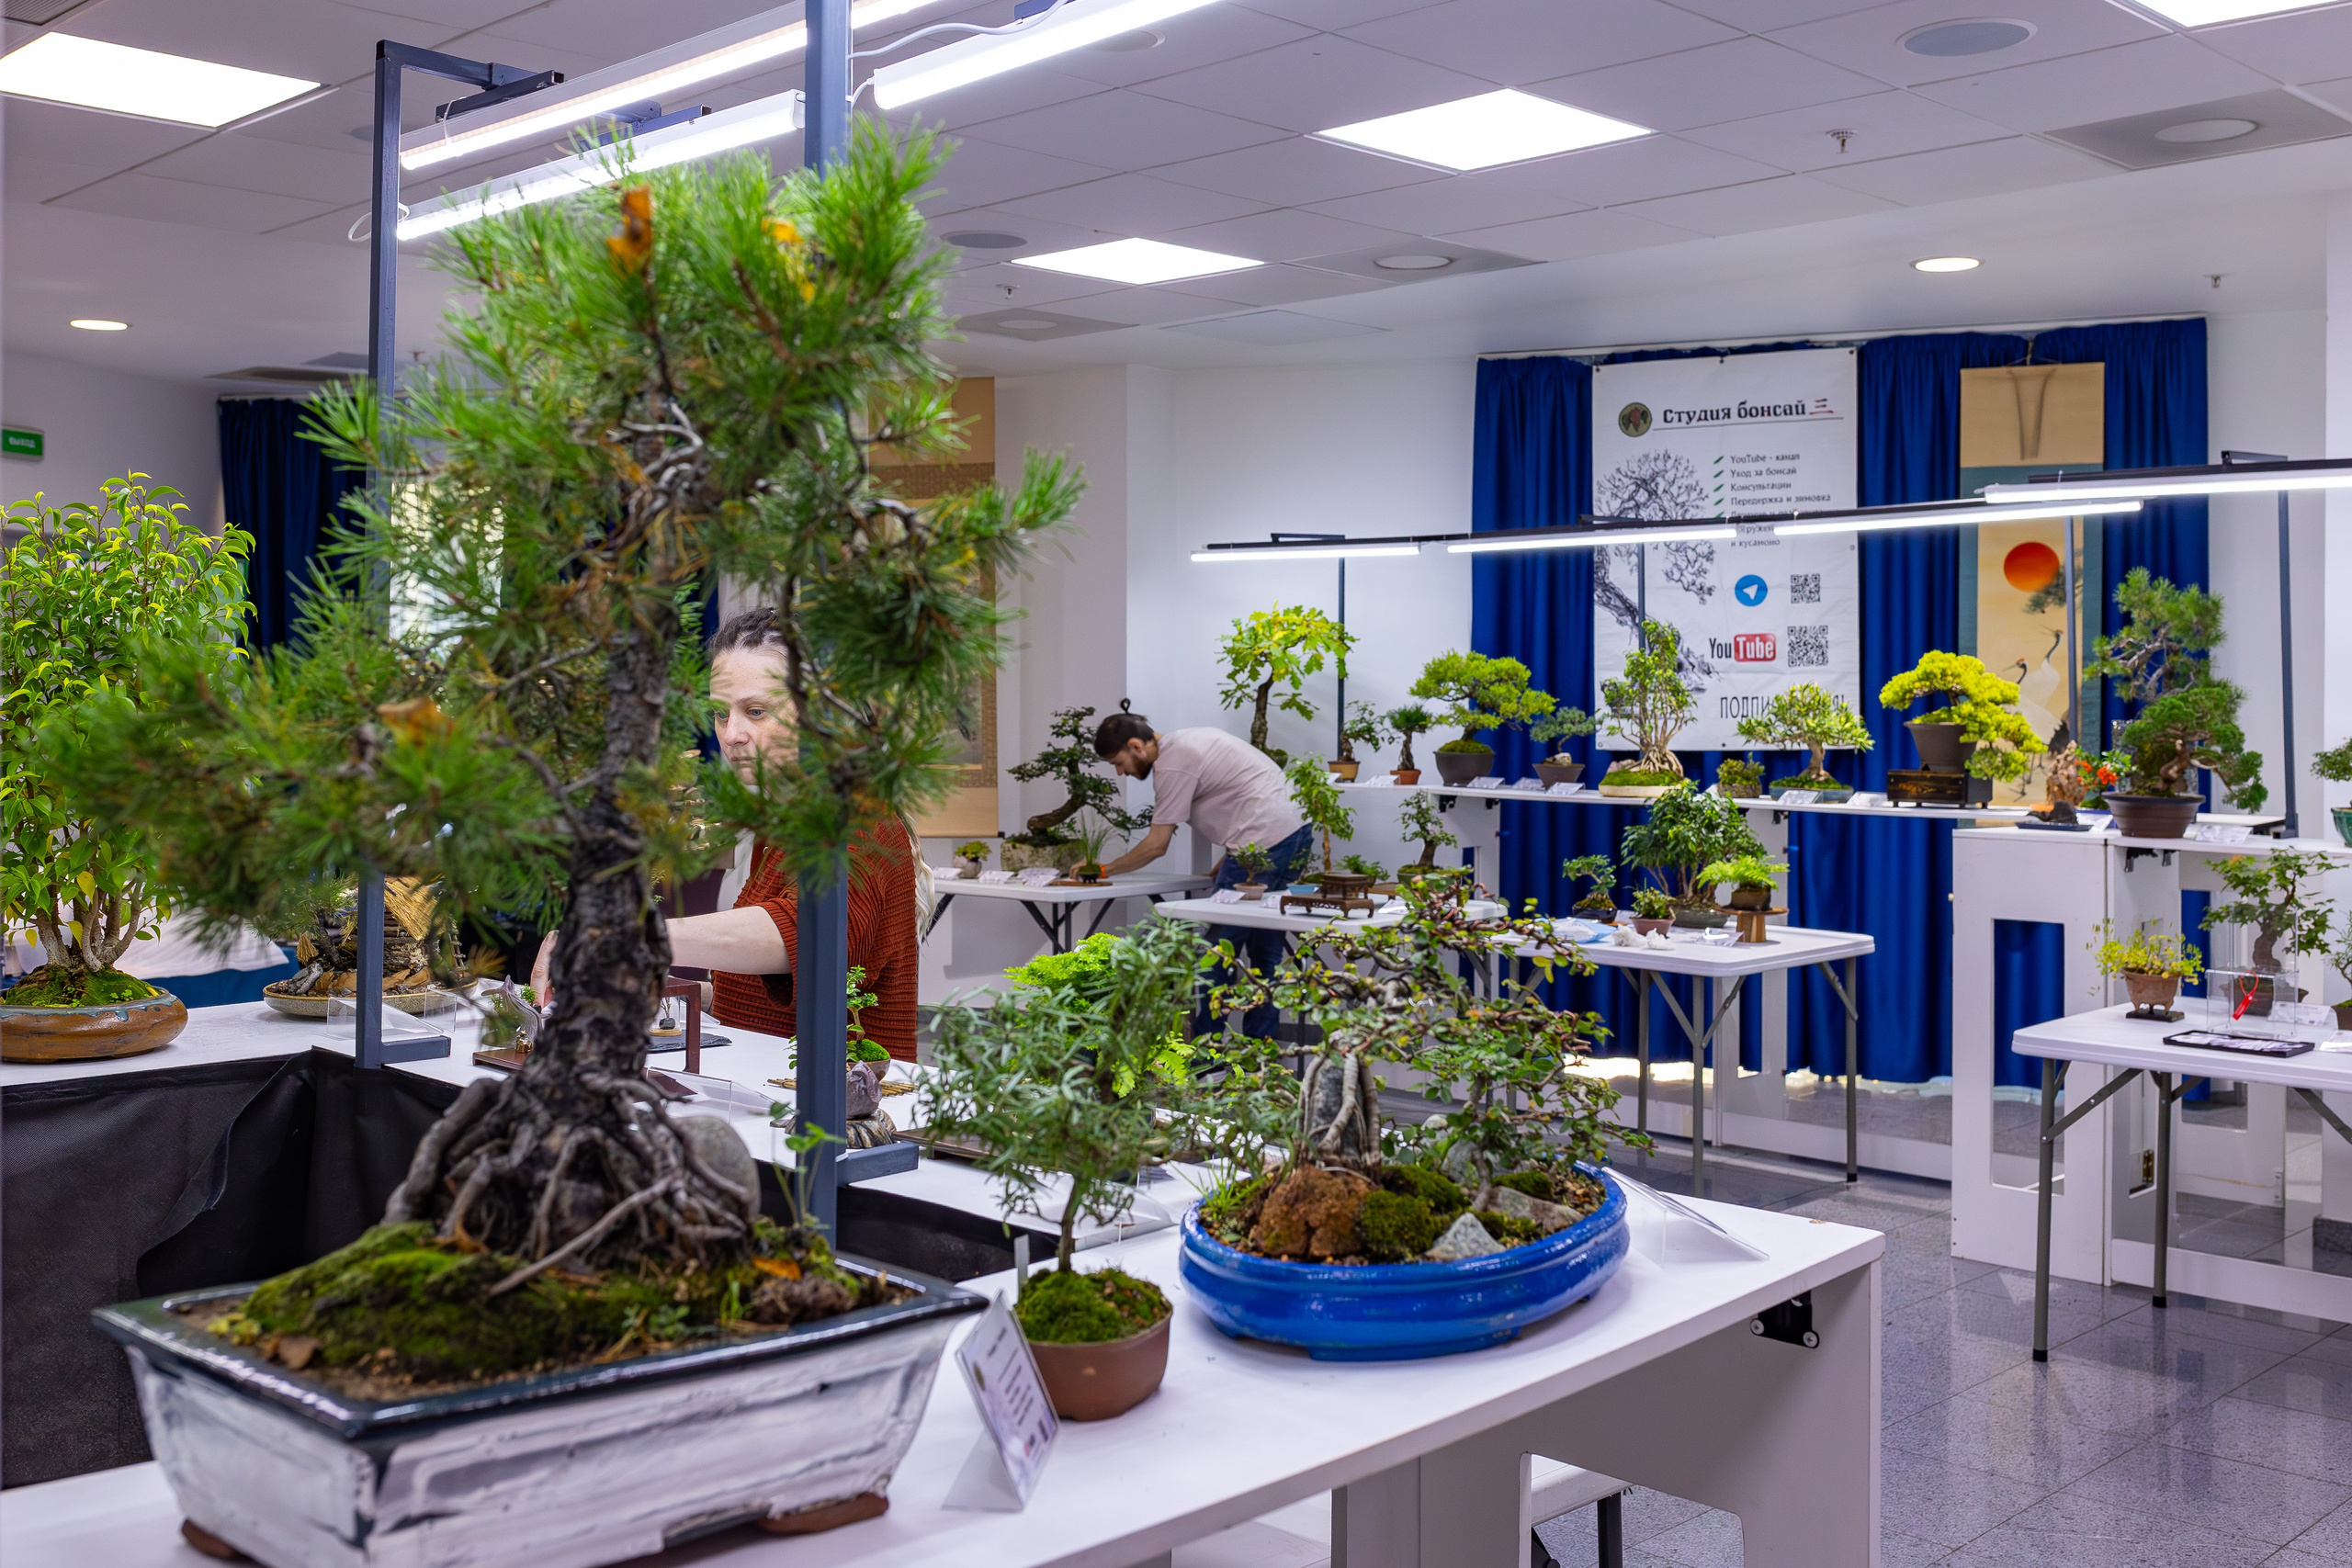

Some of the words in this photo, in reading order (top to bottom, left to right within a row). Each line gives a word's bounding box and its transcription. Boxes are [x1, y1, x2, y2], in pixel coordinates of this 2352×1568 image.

[1663, 407, 1731, 425] Студия
[1736, 400, 1806, 419] бонсай
[1730, 454, 1767, 464] YouTube
[1775, 453, 1800, 461] канал
[1730, 468, 1751, 479] Уход
[1765, 467, 1797, 476] бонсай
[1730, 482, 1792, 492] Консультации
[1730, 497, 1783, 506] Передержка
[1794, 494, 1831, 502] зимовка
[1709, 636, 1774, 660] YouTube
